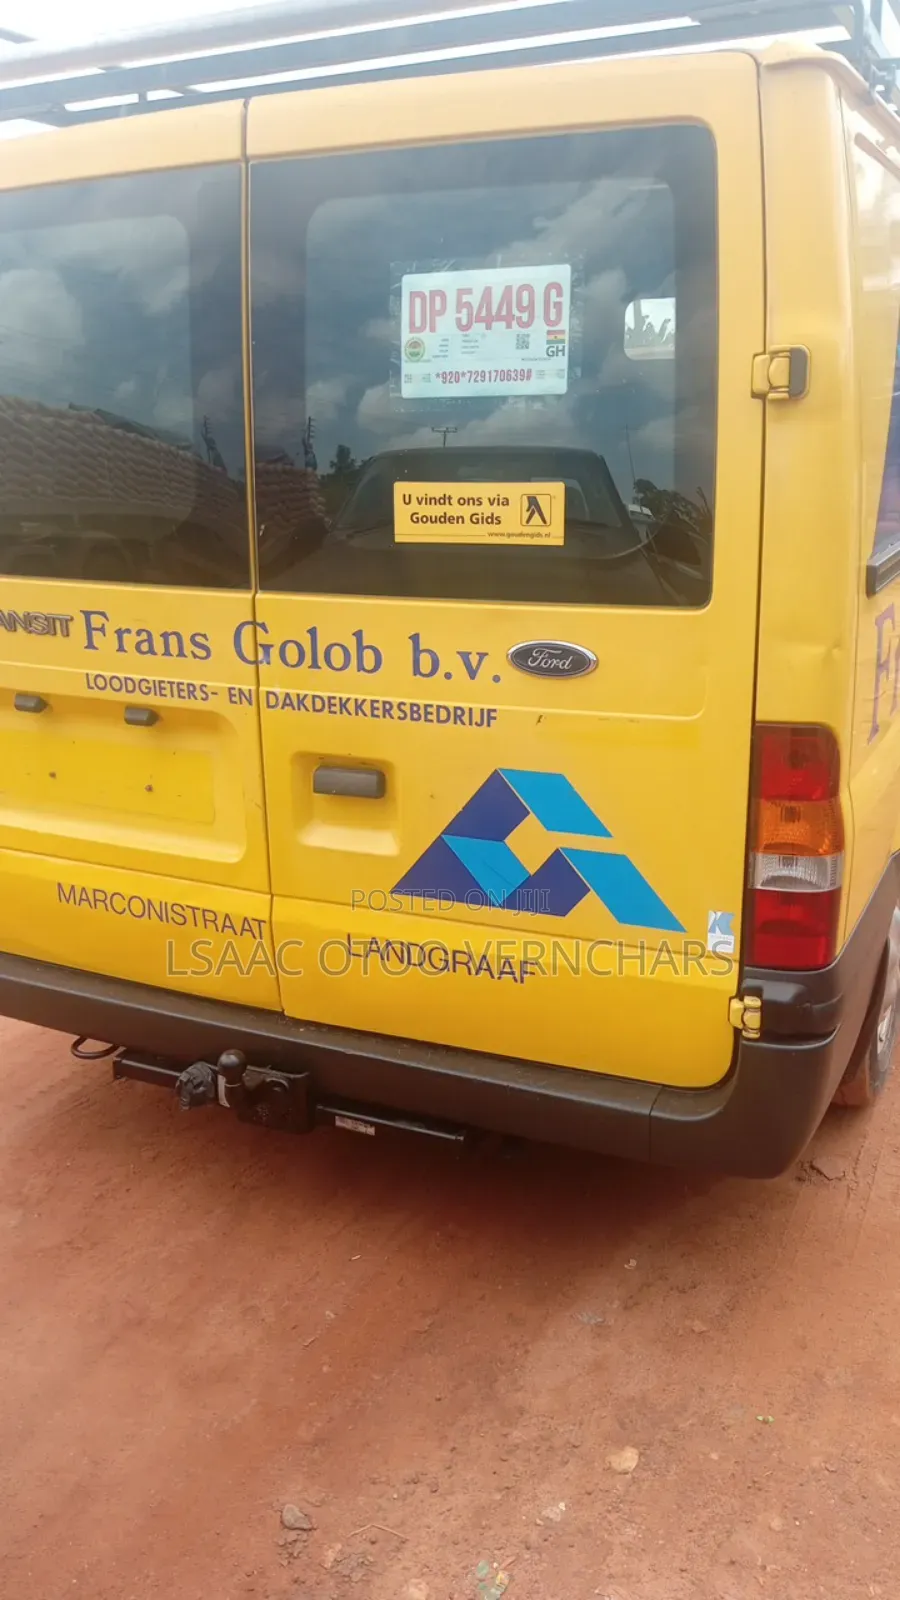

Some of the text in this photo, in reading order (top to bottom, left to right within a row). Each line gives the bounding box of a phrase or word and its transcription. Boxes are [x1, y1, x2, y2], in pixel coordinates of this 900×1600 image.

[409, 282, 564, 334] DP 5449 G
[546, 345, 565, 357] GH
[402, 493, 510, 506] U vindt ons via
[410, 512, 502, 525] Gouden Gids
[80, 609, 501, 684] Frans Golob b.v.
[528, 647, 575, 670] Ford
[85, 673, 498, 728] LOODGIETERS- EN DAKDEKKERSBEDRIJF
[57, 882, 266, 940] MARCONISTRAAT
[347, 932, 538, 984] LANDGRAAF
